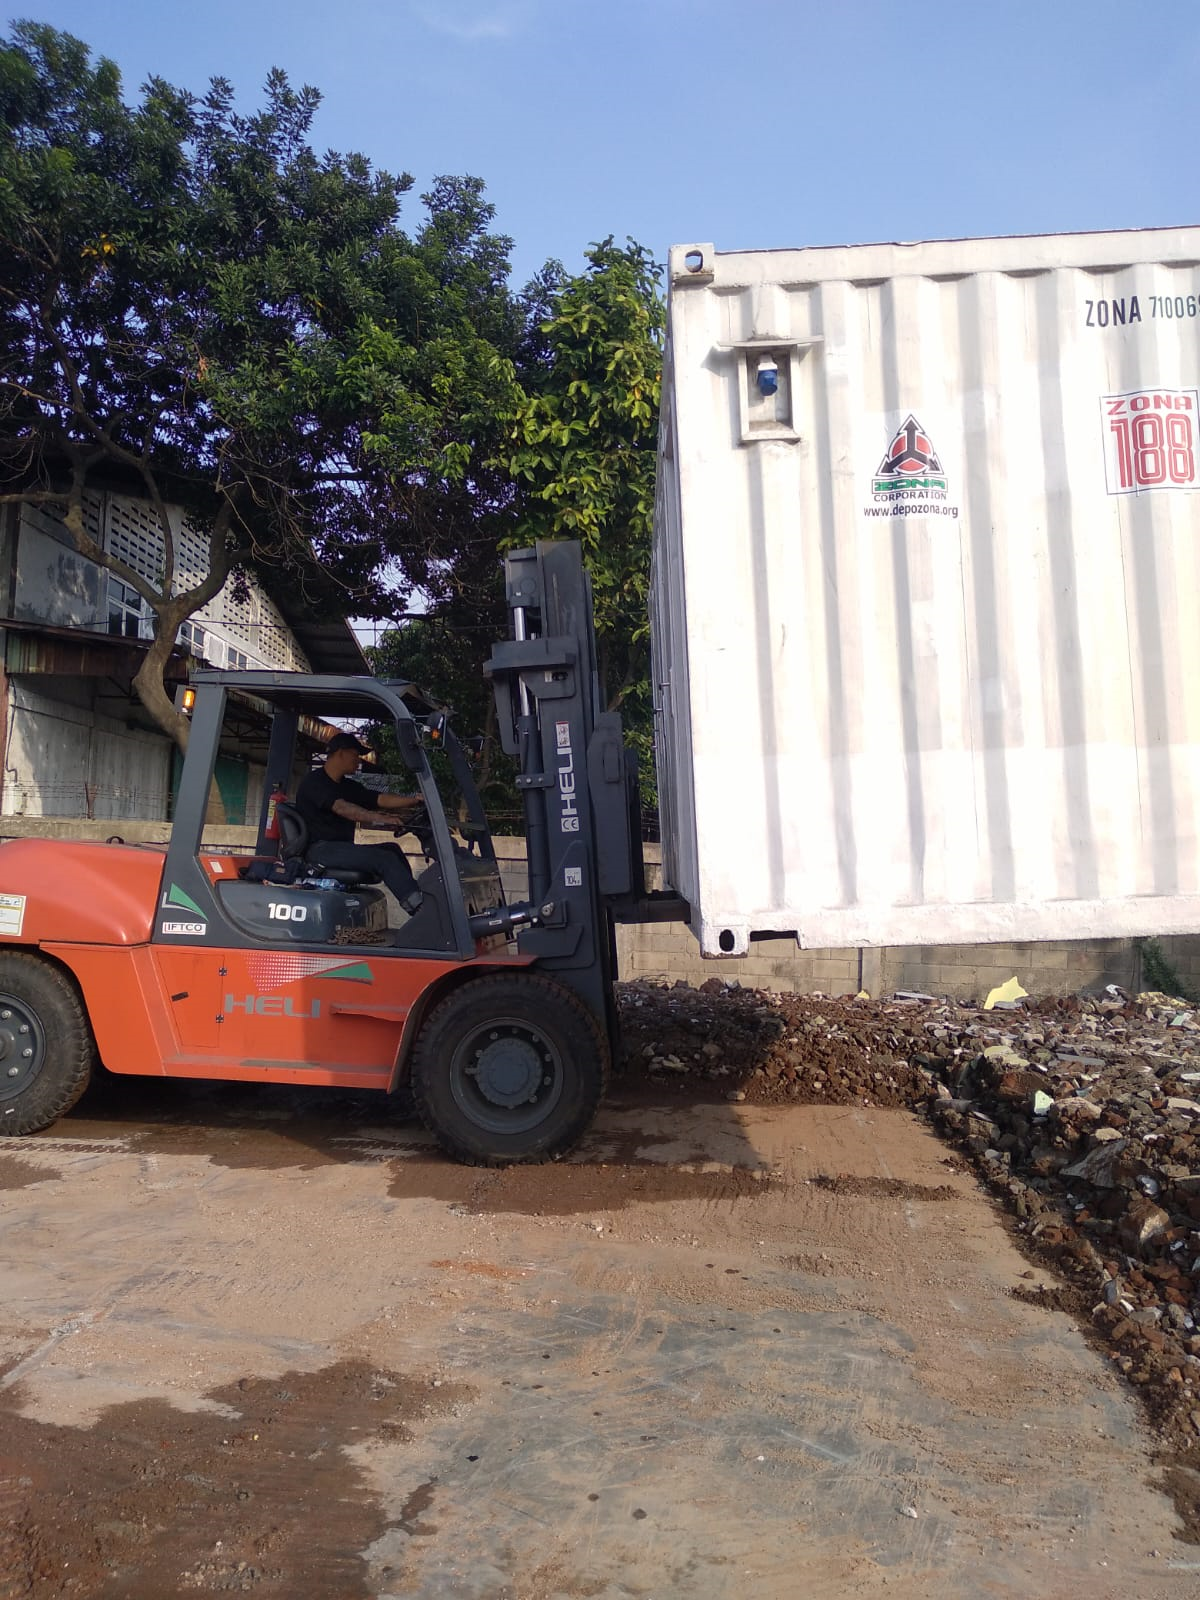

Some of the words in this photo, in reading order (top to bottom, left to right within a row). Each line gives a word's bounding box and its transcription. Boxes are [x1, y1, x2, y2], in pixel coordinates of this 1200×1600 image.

[1085, 296, 1142, 327] ZONA
[1105, 395, 1193, 415] ZONA
[1111, 413, 1195, 488] 188
[874, 479, 946, 492] ZONA
[873, 491, 947, 502] CORPORATION
[863, 504, 959, 519] www.depozona.org
[557, 747, 577, 815] HELI
[267, 902, 307, 922] 100
[224, 993, 320, 1018] HELI
